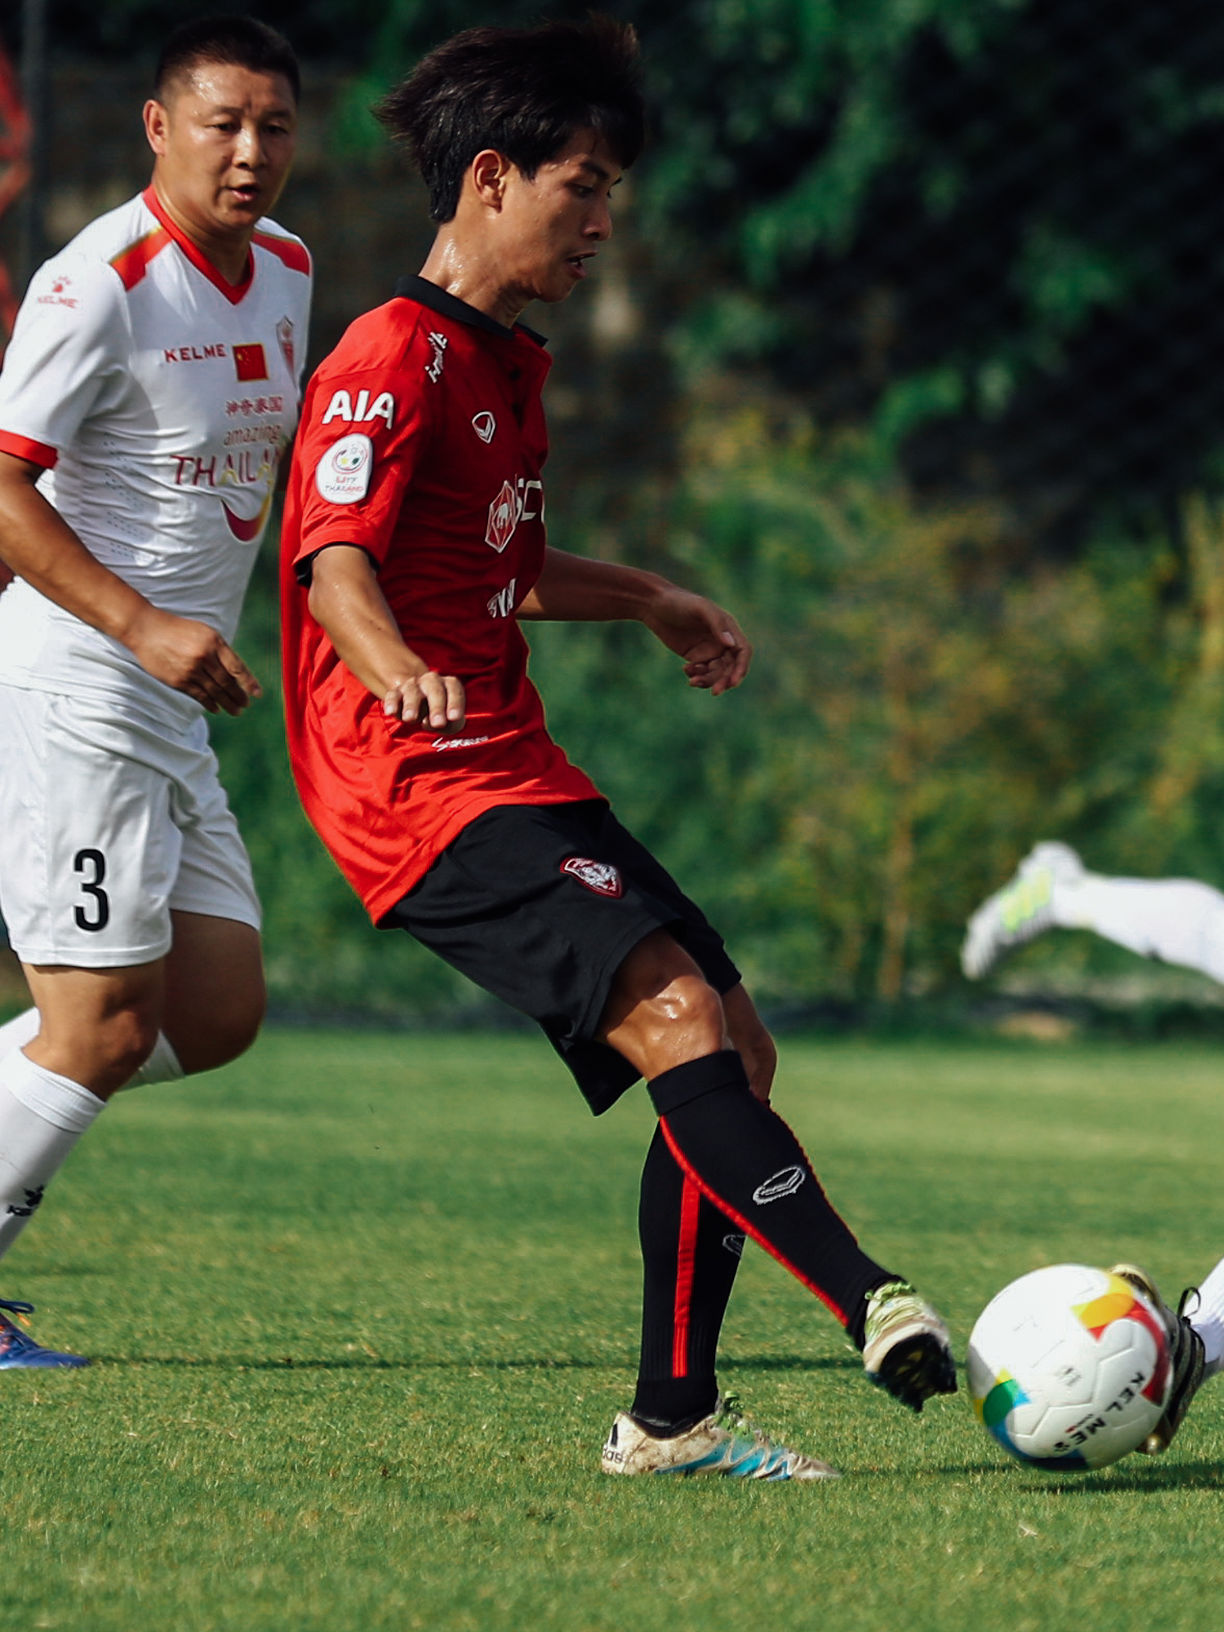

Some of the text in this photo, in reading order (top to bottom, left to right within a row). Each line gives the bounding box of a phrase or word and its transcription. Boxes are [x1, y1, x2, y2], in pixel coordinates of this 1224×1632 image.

[164, 344, 227, 363] KELME
[322, 390, 394, 429] AIA
[223, 421, 281, 446] amazing
[73, 848, 110, 932] 3
[1070, 1371, 1146, 1445] KELME
